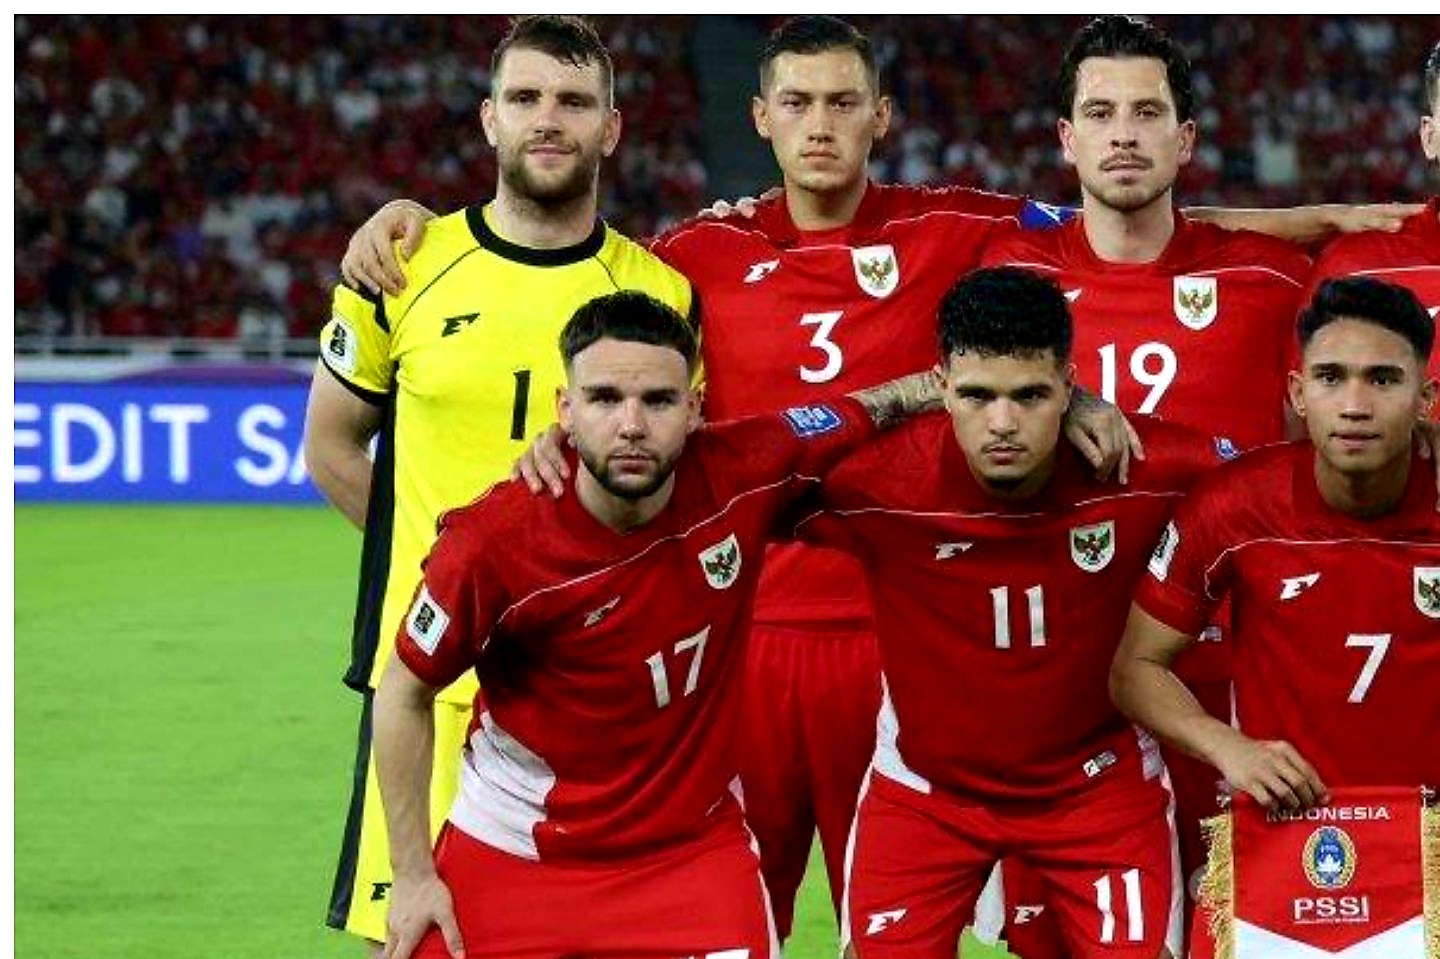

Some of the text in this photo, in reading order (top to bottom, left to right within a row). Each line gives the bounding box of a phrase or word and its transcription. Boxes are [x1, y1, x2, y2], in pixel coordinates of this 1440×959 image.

[799, 310, 845, 384] 3
[1097, 341, 1178, 415] 19
[511, 369, 531, 441] 1
[236, 402, 308, 486] S
[988, 584, 1046, 650] 11
[645, 625, 712, 709] 17
[1344, 632, 1393, 704] 7
[1092, 867, 1146, 944] 11
[1294, 896, 1369, 920] PSSI
